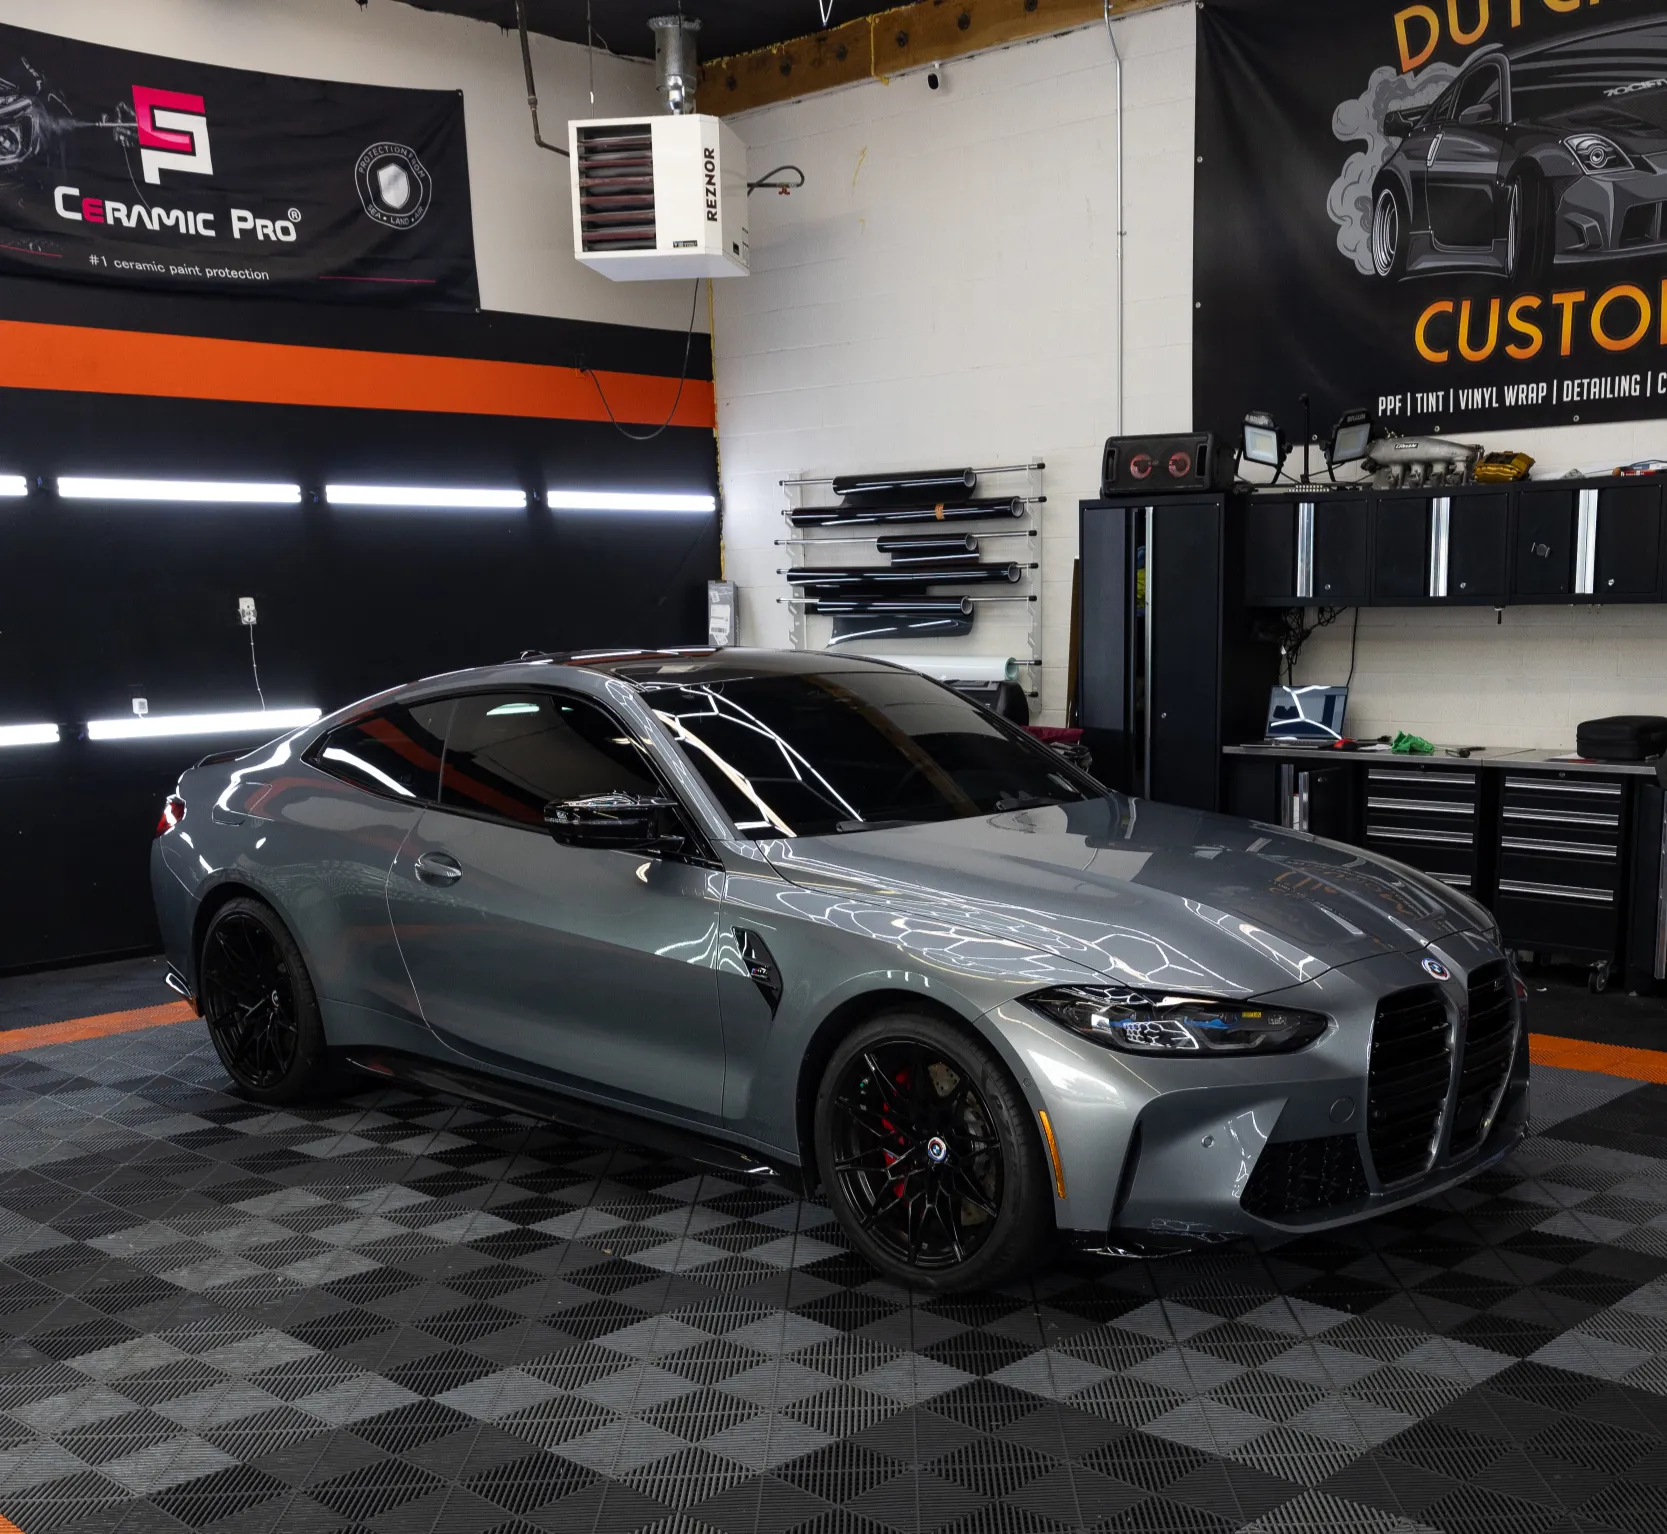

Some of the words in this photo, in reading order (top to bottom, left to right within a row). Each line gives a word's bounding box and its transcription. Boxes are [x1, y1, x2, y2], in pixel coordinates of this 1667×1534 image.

[358, 145, 408, 174] PROTECTION
[409, 153, 426, 177] FROM
[704, 148, 718, 221] REZNOR
[367, 203, 381, 219] SEA
[390, 215, 410, 225] LAND
[414, 206, 424, 219] AIR
[89, 254, 108, 267] #1
[114, 258, 166, 273] ceramic
[169, 264, 202, 277] paint
[205, 266, 270, 281] protection
[1414, 278, 1667, 364] CUSTO
[1378, 394, 1402, 417] PPF
[1415, 390, 1445, 414] TINT
[1459, 386, 1499, 410] VINYL
[1504, 382, 1547, 407] WRAP
[1562, 374, 1641, 402] DETAILING
